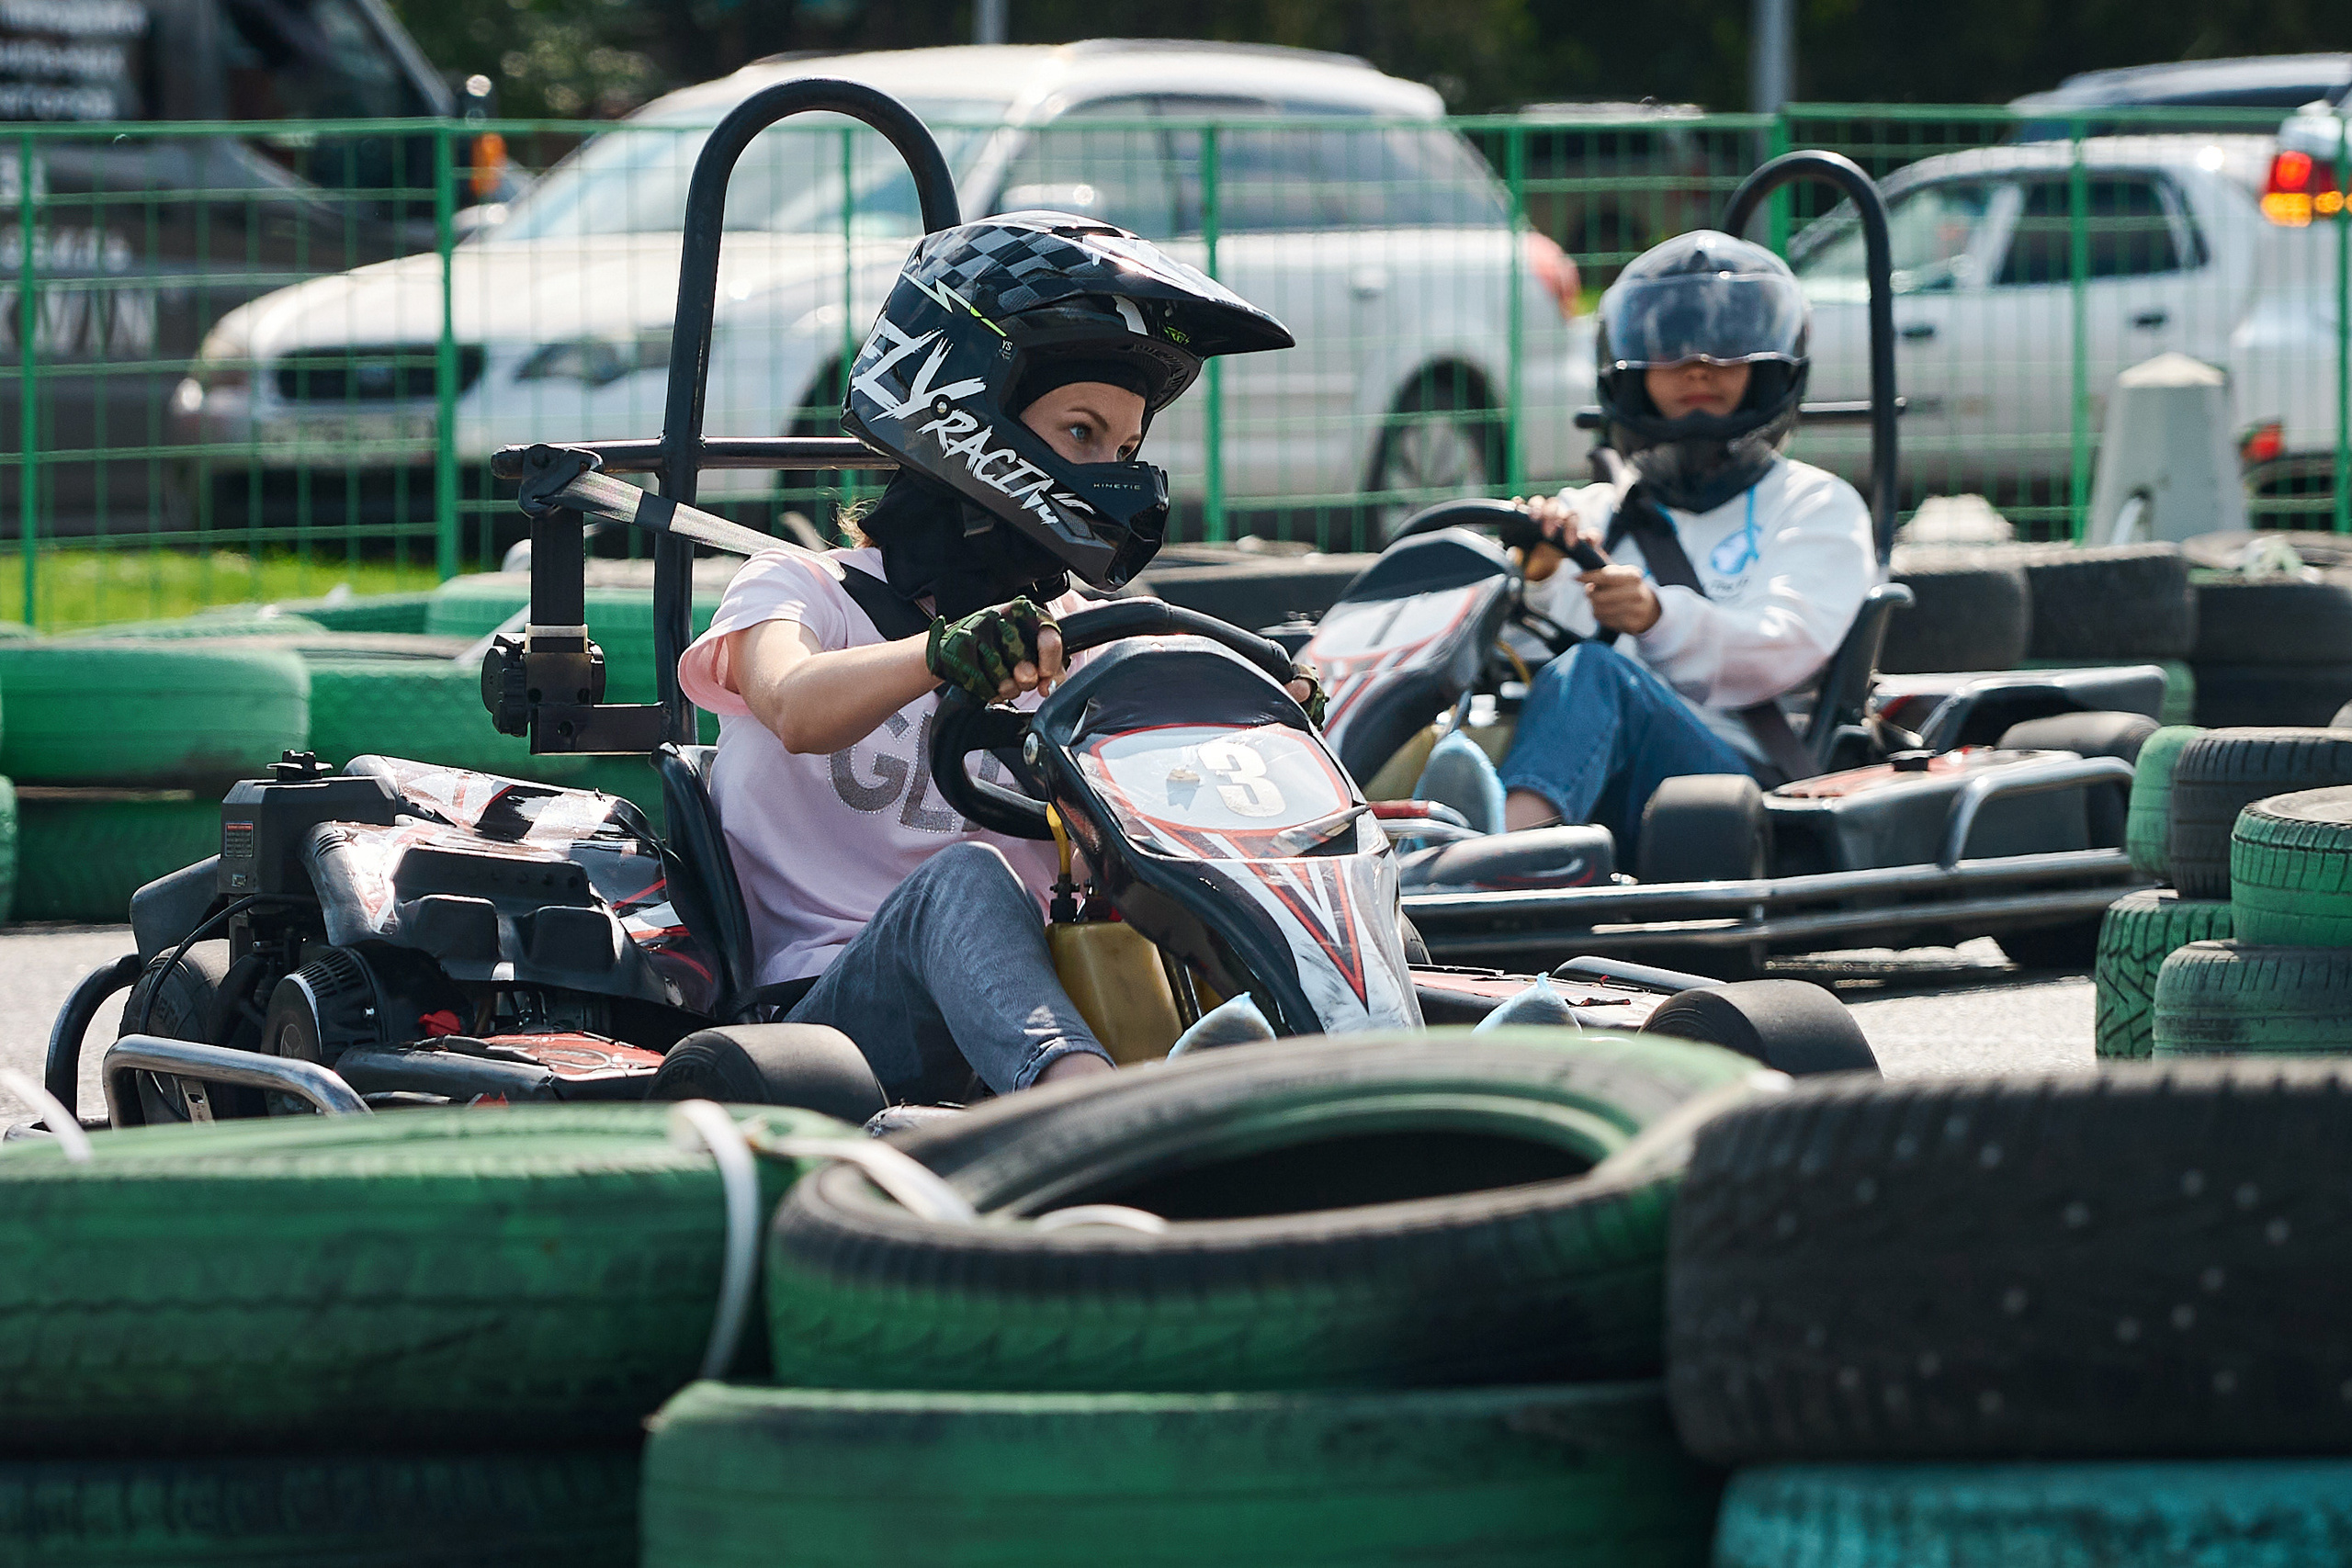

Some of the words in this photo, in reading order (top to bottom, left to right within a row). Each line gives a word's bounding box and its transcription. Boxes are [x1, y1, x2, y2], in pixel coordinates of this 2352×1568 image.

[1001, 340, 1013, 351] YS
[917, 408, 1096, 525] RACING
[1093, 482, 1141, 491] KINETIC
[1197, 742, 1286, 818] 3
